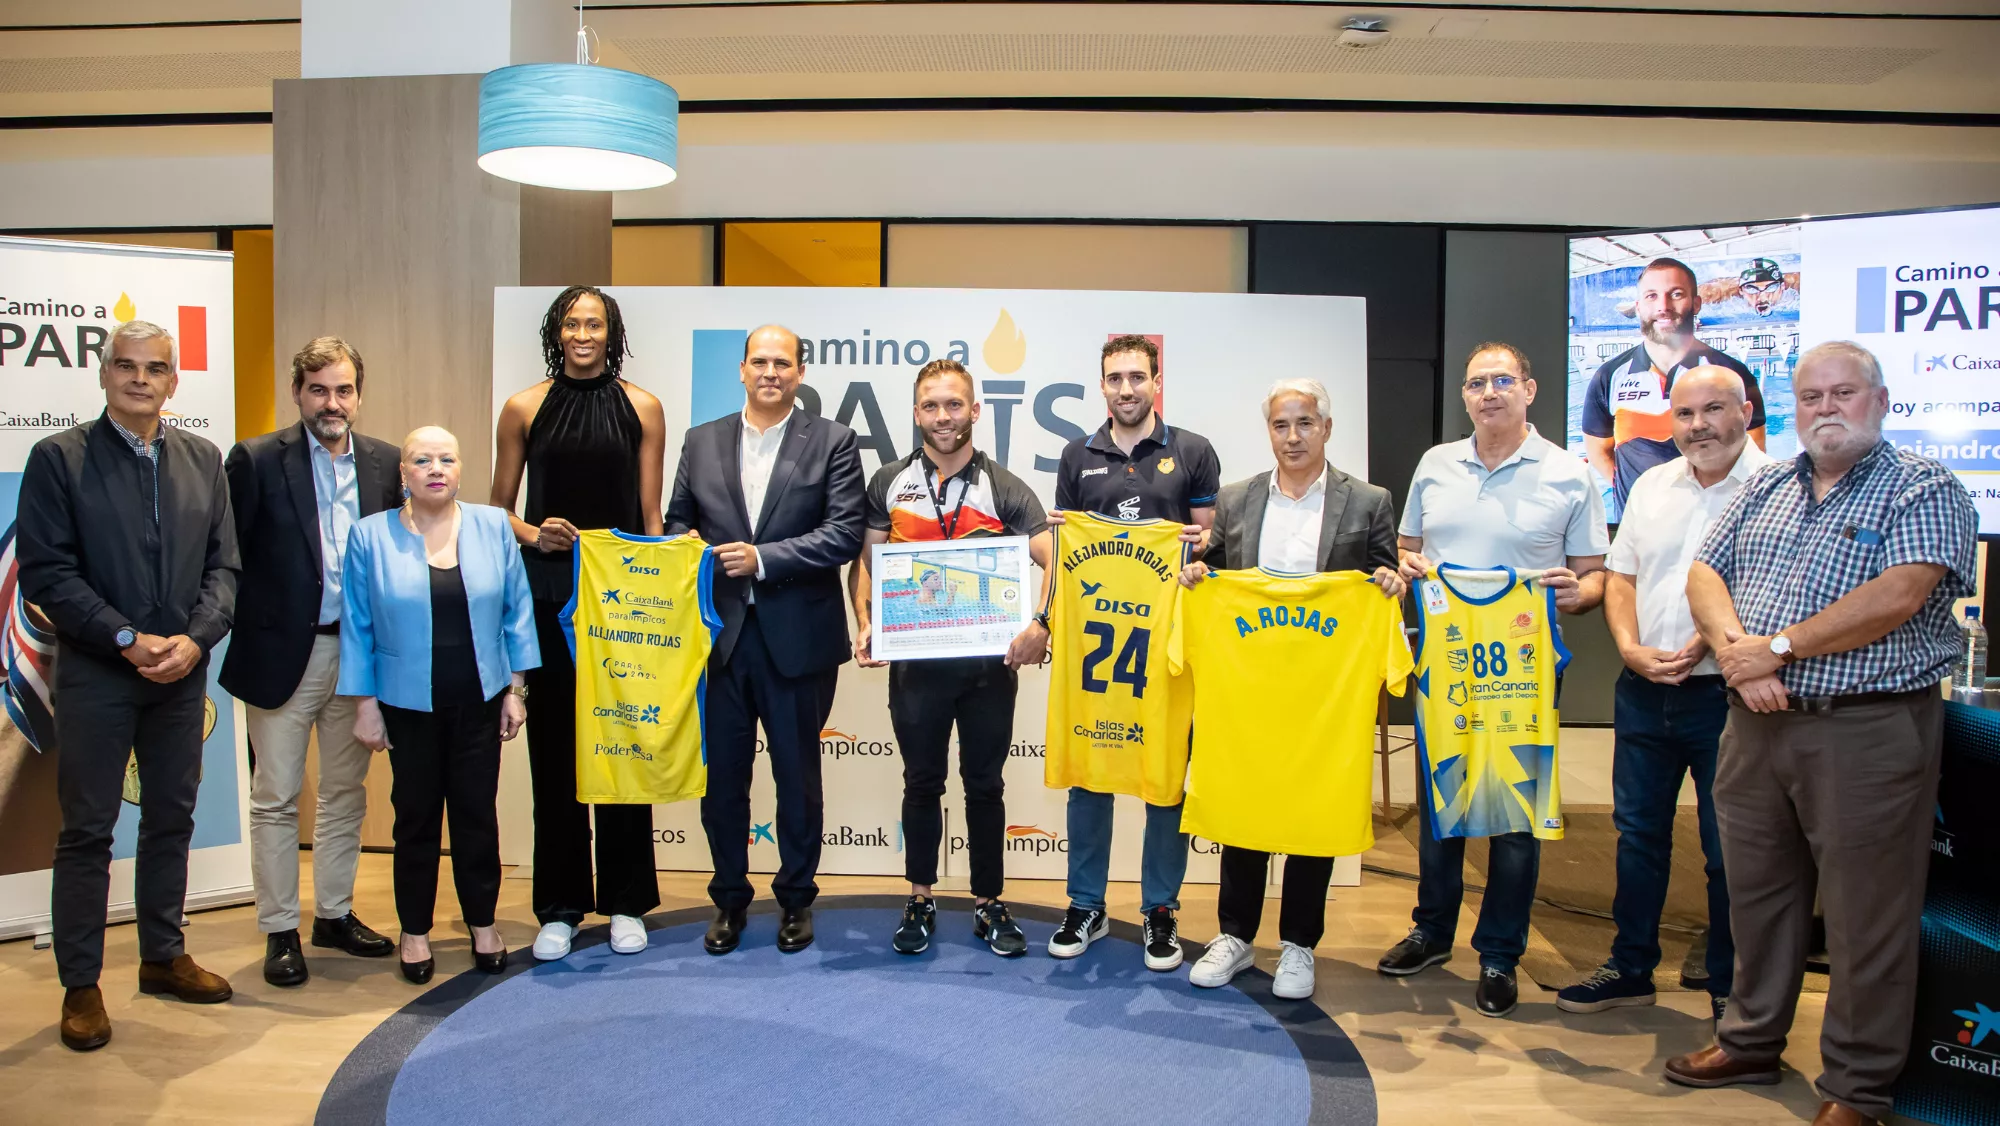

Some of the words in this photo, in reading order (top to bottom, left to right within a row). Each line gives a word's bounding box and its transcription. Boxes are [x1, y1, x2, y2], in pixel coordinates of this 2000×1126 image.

[1895, 262, 1989, 282] Camino
[94, 306, 106, 319] a
[1894, 286, 2000, 333] PAR
[0, 322, 109, 368] PAR
[801, 329, 931, 366] amino
[946, 340, 970, 366] a
[1952, 355, 2000, 370] Caixa
[1617, 391, 1651, 401] ESP
[1887, 400, 1916, 417] oy
[1063, 540, 1133, 574] ALEJANDRO
[1135, 546, 1173, 583] ROJAS
[625, 592, 674, 607] CaixaBank
[647, 633, 681, 648] ROJAS
[614, 660, 642, 670] PARIS
[1081, 620, 1151, 700] 24
[1472, 641, 1508, 678] 88
[631, 671, 657, 680] 2024
[592, 706, 639, 722] Canarias
[616, 700, 639, 712] Islas
[1074, 725, 1124, 741] Canarias
[1096, 719, 1124, 731] Islas
[1930, 1045, 2000, 1077] CaixaB
